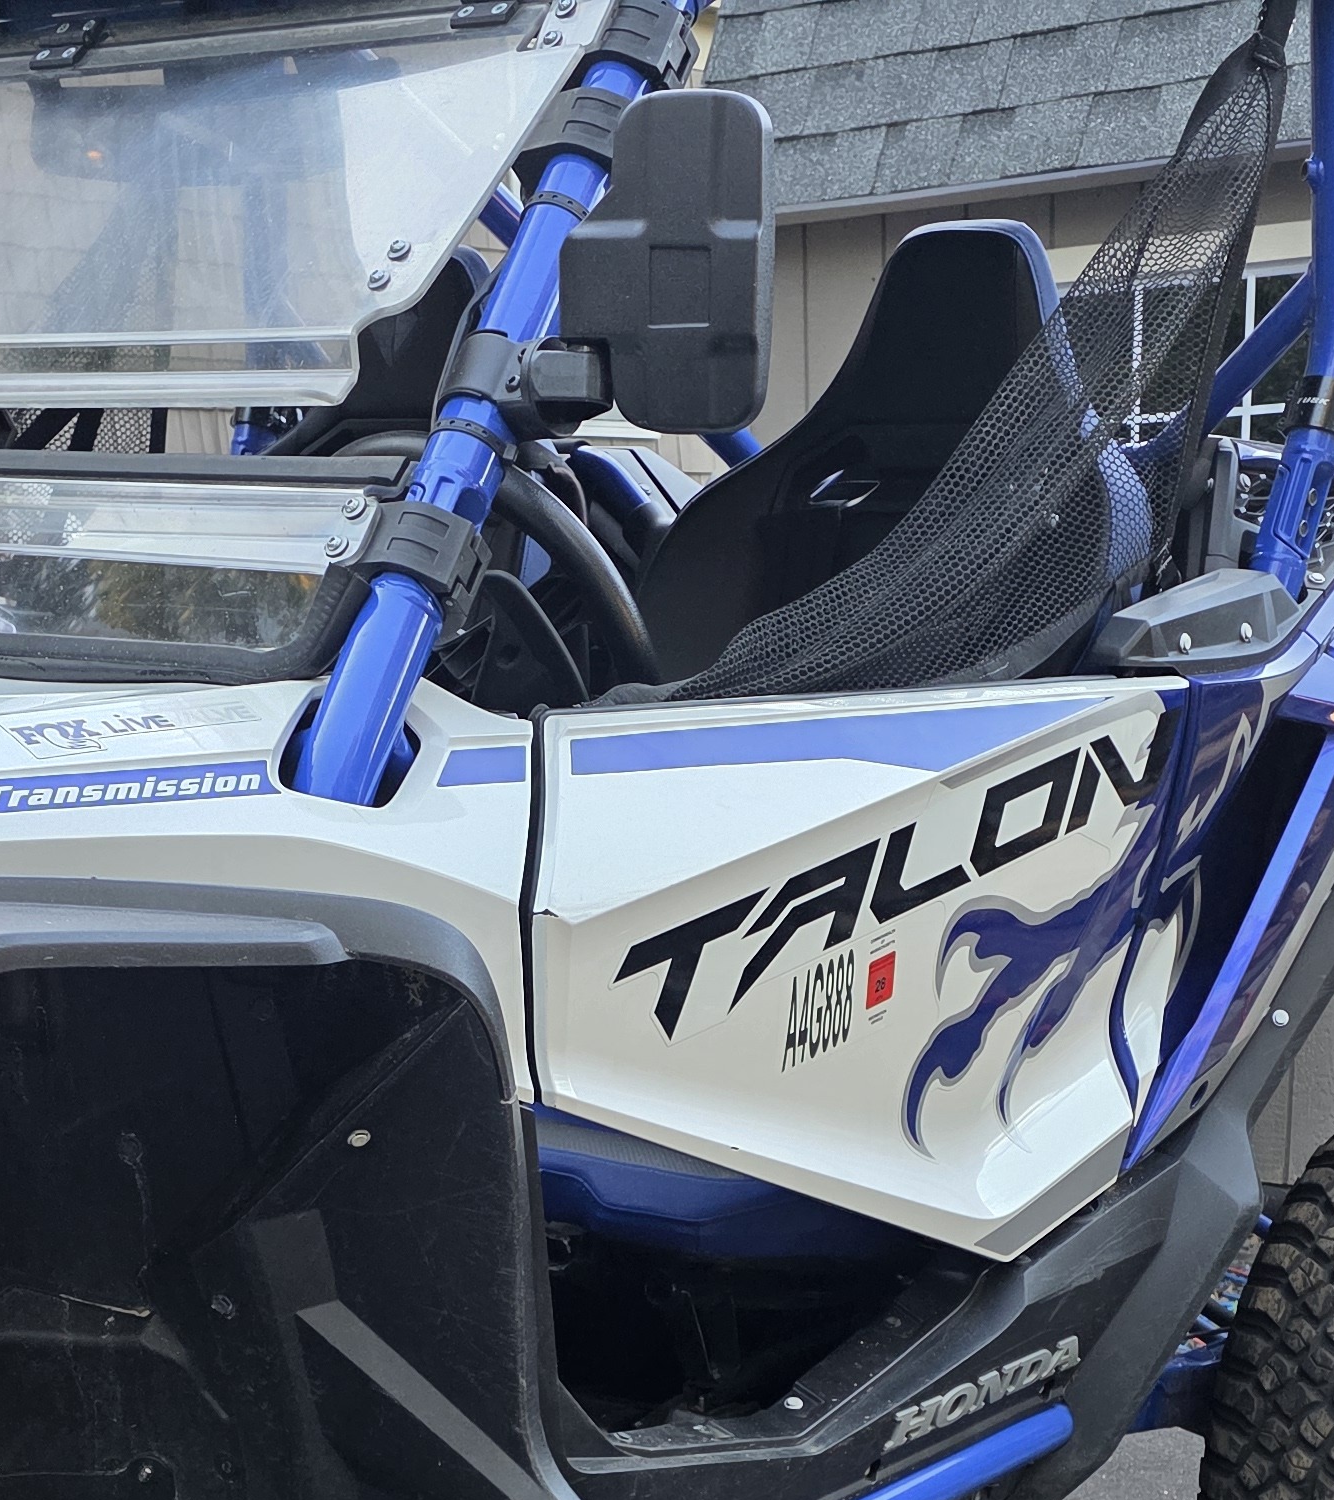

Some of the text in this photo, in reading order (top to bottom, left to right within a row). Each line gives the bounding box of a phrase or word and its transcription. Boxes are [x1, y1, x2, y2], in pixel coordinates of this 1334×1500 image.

[8, 718, 103, 750] FOX
[611, 708, 1183, 1042] TALON
[781, 948, 855, 1074] A4G888
[882, 1335, 1082, 1452] HONDA
